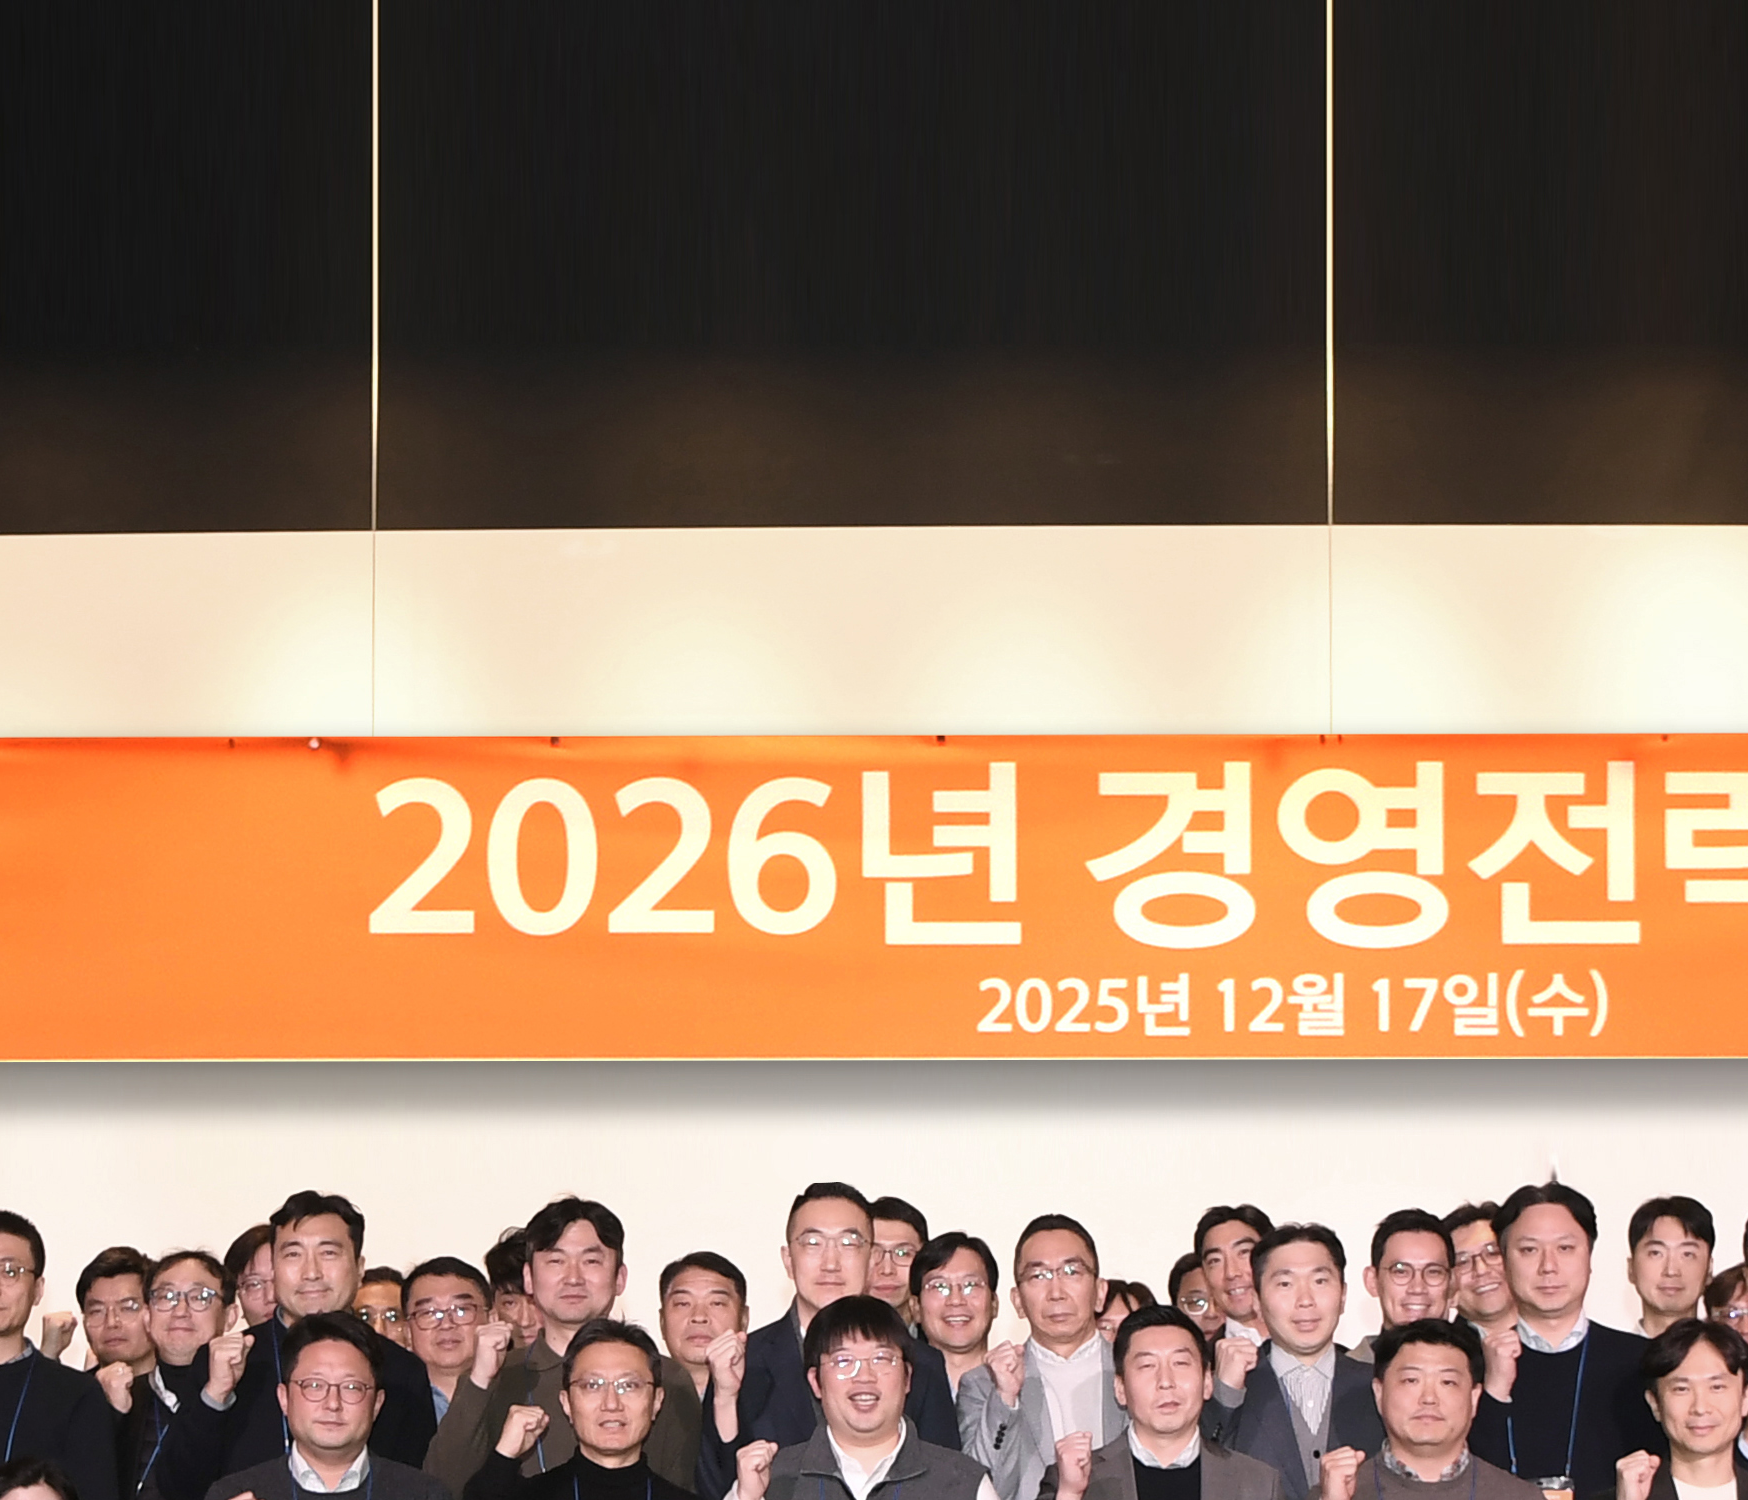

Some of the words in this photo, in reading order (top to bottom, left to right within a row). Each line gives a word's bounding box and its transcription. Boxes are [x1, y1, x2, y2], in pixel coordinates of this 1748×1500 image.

[368, 761, 1022, 946] 2026년
[976, 971, 1191, 1036] 2025년
[1216, 972, 1345, 1036] 12월
[1370, 969, 1608, 1037] 17일(수)
